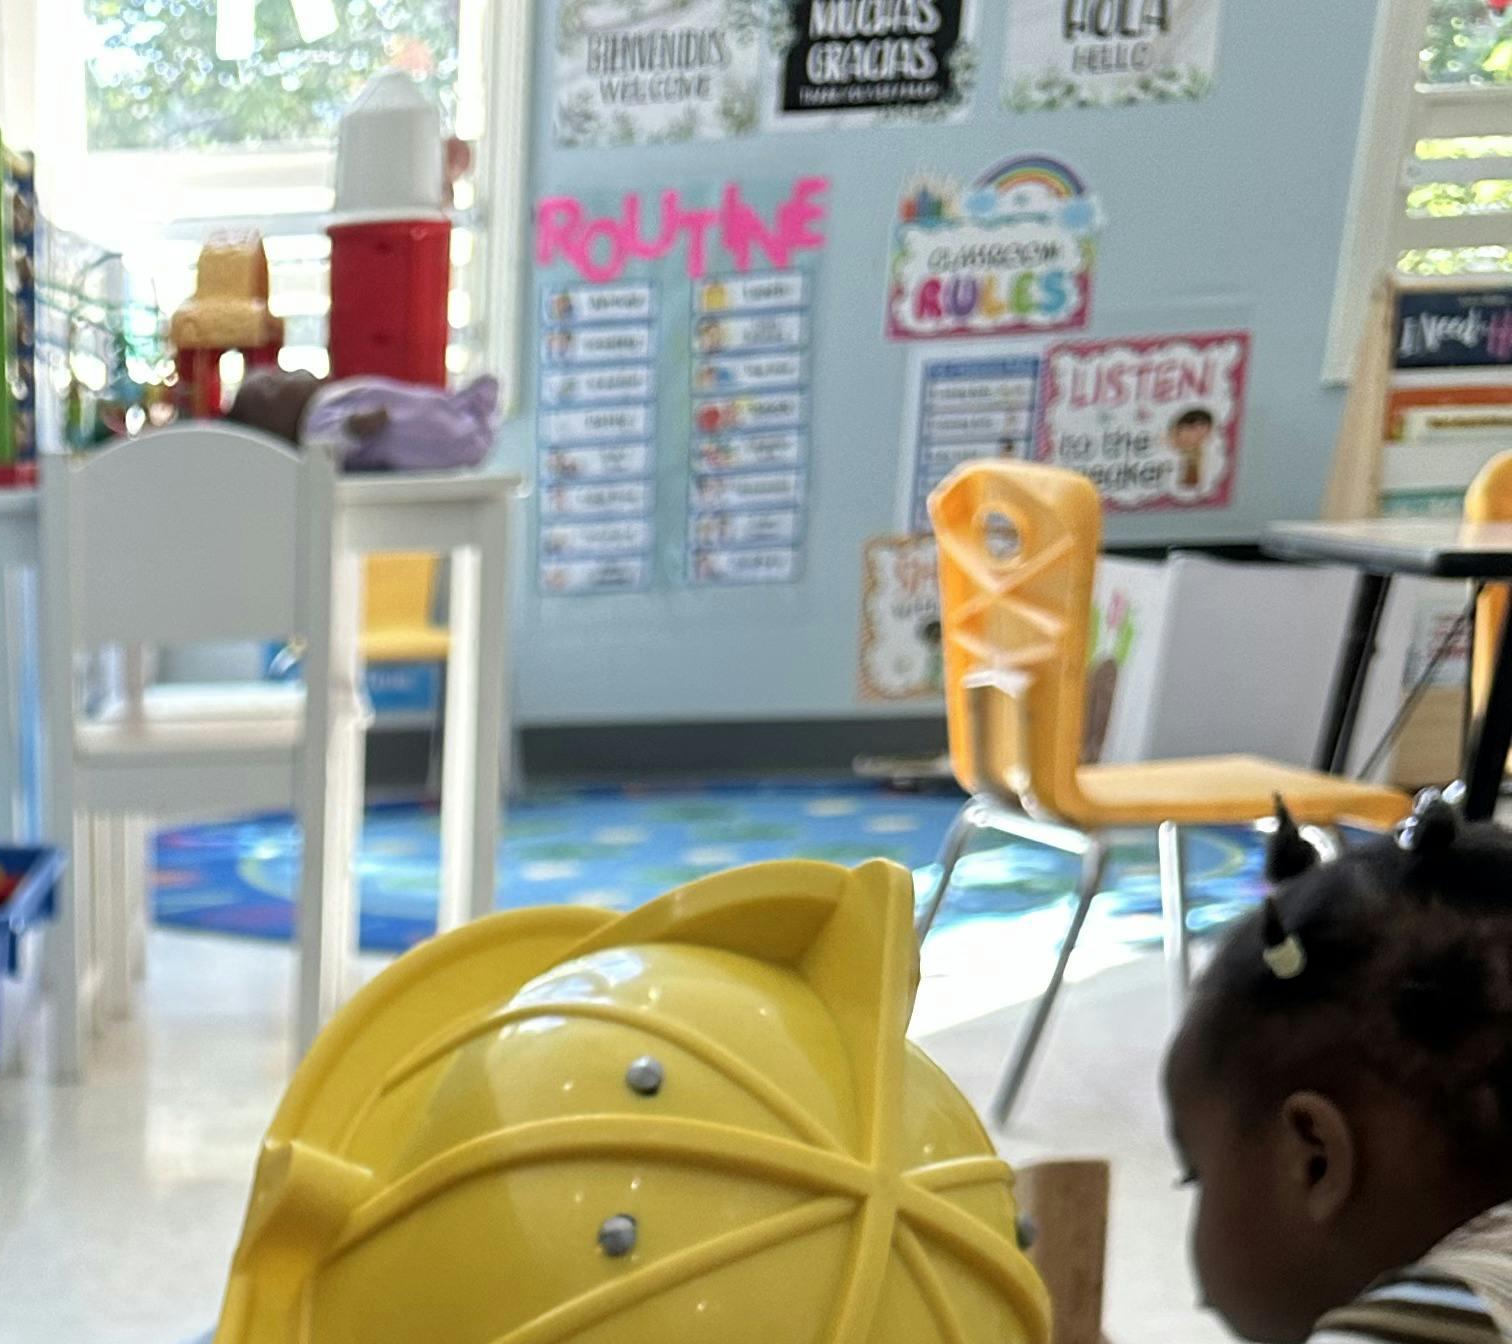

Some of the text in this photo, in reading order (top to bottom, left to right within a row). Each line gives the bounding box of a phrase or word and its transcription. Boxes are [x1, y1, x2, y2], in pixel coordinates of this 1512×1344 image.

[1064, 0, 1170, 39] HOLA
[586, 30, 730, 74] BIENVENIDOS
[806, 37, 939, 84] GRACIAS
[1072, 41, 1157, 75] HELLO
[599, 73, 712, 104] WELCOME
[536, 176, 831, 283] ROUTINE
[912, 268, 1069, 321] RULES
[1070, 359, 1214, 409] LISTEN
[1059, 428, 1151, 460] to the
